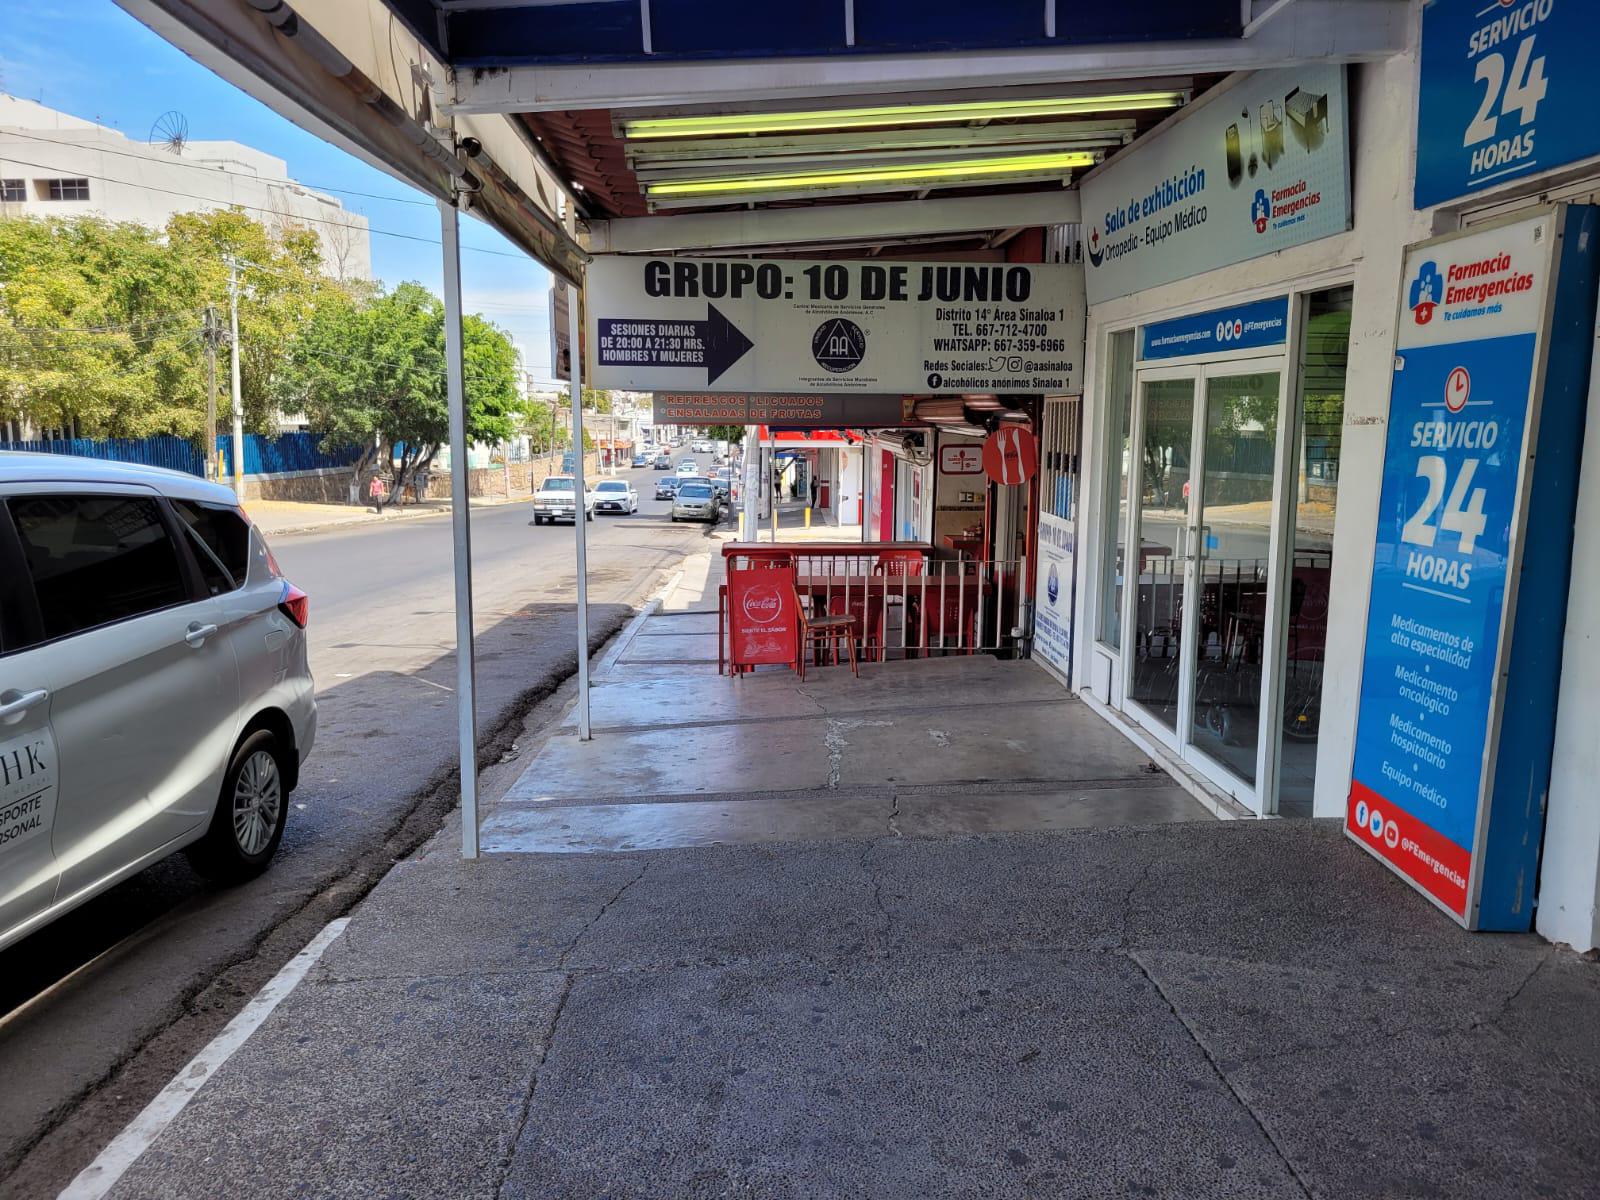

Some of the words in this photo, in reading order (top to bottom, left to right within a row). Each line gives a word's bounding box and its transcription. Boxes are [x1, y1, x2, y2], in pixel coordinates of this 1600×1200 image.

[1467, 0, 1553, 58] SERVICIO
[1463, 33, 1549, 148] 24
[1469, 129, 1536, 175] HORAS
[1105, 206, 1126, 235] Sala
[1127, 198, 1141, 225] de
[1142, 165, 1206, 219] exhibición
[1272, 180, 1306, 203] Farmacia
[1272, 192, 1321, 218] Emergencias
[1105, 234, 1138, 262] Ortopedia
[1145, 219, 1173, 245] Equipo
[1174, 205, 1208, 232] Médico
[644, 260, 794, 299] GRUPO:
[802, 263, 849, 301] 10
[860, 265, 908, 301] DE
[917, 266, 1031, 302] JUNIO
[1447, 252, 1511, 283] Farmacia
[1445, 272, 1534, 304] Emergencias
[936, 308, 972, 321] Distrito
[994, 306, 1017, 322] Área
[1019, 308, 1053, 322] Sinaloa
[1060, 309, 1064, 322] 1
[1444, 312, 1451, 321] Te
[1452, 306, 1486, 320] cuidamos
[1487, 302, 1503, 314] más
[601, 337, 613, 348] DE
[616, 337, 643, 349] 20:00
[645, 337, 652, 349] A
[654, 338, 681, 349] 21:30
[683, 338, 705, 350] HRS.
[611, 323, 656, 336] SESIONES
[658, 324, 695, 337] DIARIAS
[829, 336, 848, 355] AA
[934, 339, 991, 352] WHATSAPP:
[993, 339, 1065, 352] 667-359-6966
[953, 324, 973, 337] TEL.
[975, 324, 1048, 337] 667-712-4700
[603, 350, 649, 361] HOMBRES
[651, 350, 658, 361] Y
[660, 351, 704, 363] MUJERES
[924, 359, 949, 371] Redes
[951, 360, 988, 372] Sociales:
[1024, 360, 1073, 373] @aasinaloa
[943, 375, 990, 388] alcohólicos
[1032, 376, 1064, 388] Sinaloa
[1066, 377, 1070, 388] 1
[666, 408, 746, 418] ENSALADAS
[750, 409, 767, 418] DE
[770, 409, 821, 418] FRUTAS
[667, 395, 746, 405] REFRESCOS
[756, 396, 824, 406] LICUADOS
[1410, 421, 1499, 449] SERVICIO
[1401, 455, 1488, 555] 24
[1406, 551, 1473, 590] HORAS
[1391, 613, 1460, 649] Medicamentos
[1461, 636, 1474, 653] de
[1391, 631, 1409, 648] alta
[1411, 641, 1471, 670] especialidad
[1394, 664, 1458, 702] Medicamento
[1399, 685, 1450, 716] oncológico
[1389, 713, 1452, 755] Medicamento
[1391, 730, 1446, 769] hospitalario
[1382, 760, 1412, 789] Equipo
[1413, 779, 1447, 809] médico
[1401, 837, 1466, 889] @FEmergencias
